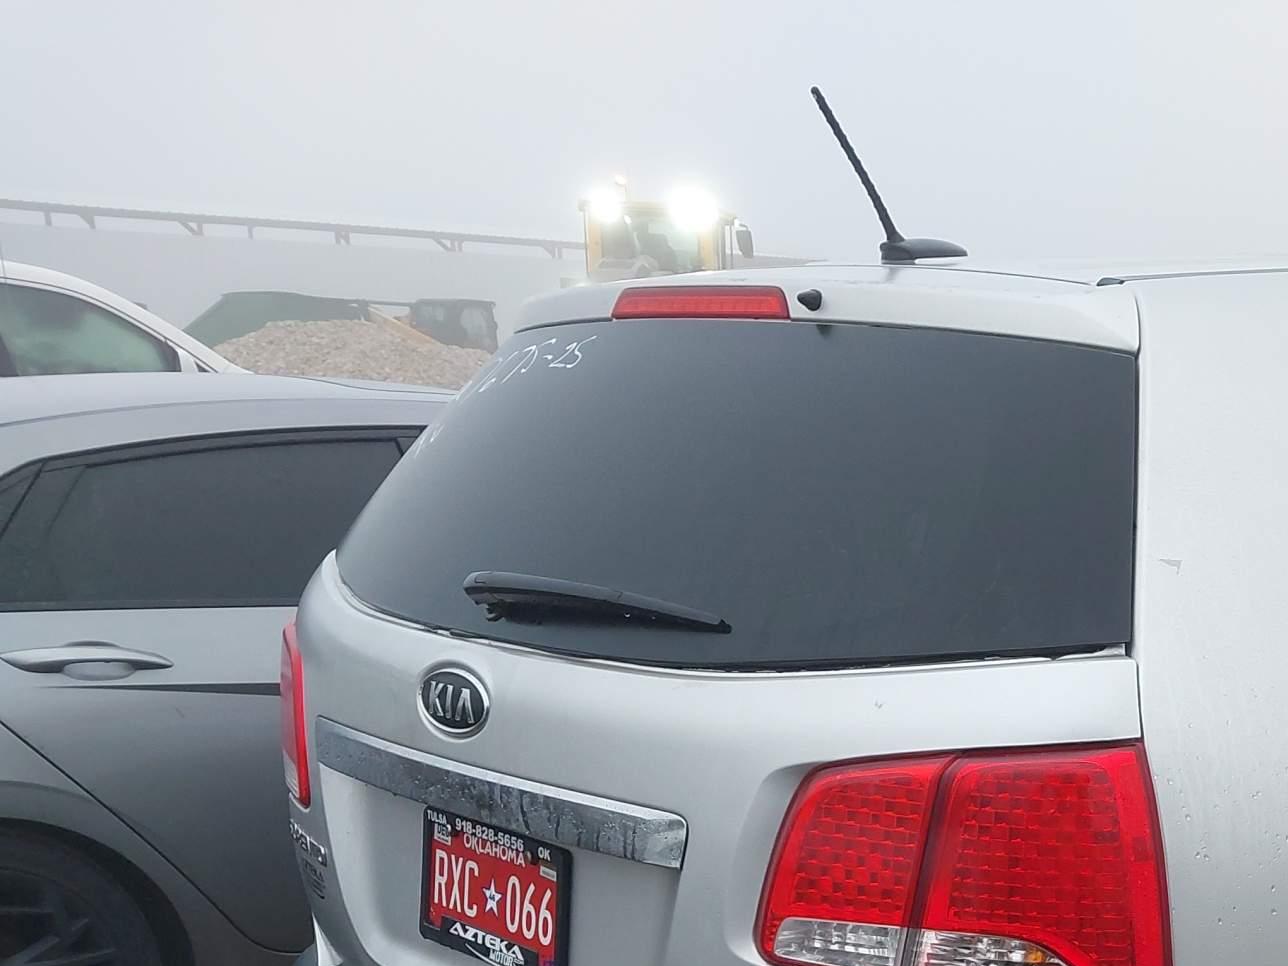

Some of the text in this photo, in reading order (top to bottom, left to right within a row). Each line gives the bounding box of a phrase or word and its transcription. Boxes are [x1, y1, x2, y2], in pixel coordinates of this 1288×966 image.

[429, 681, 475, 724] KIA
[426, 810, 447, 825] TULSA
[455, 818, 524, 851] 918-828-5656
[537, 847, 551, 861] OK
[463, 833, 525, 867] OKLAHOMA
[434, 848, 553, 946] RXC 066
[449, 921, 524, 960] AZTEKA
